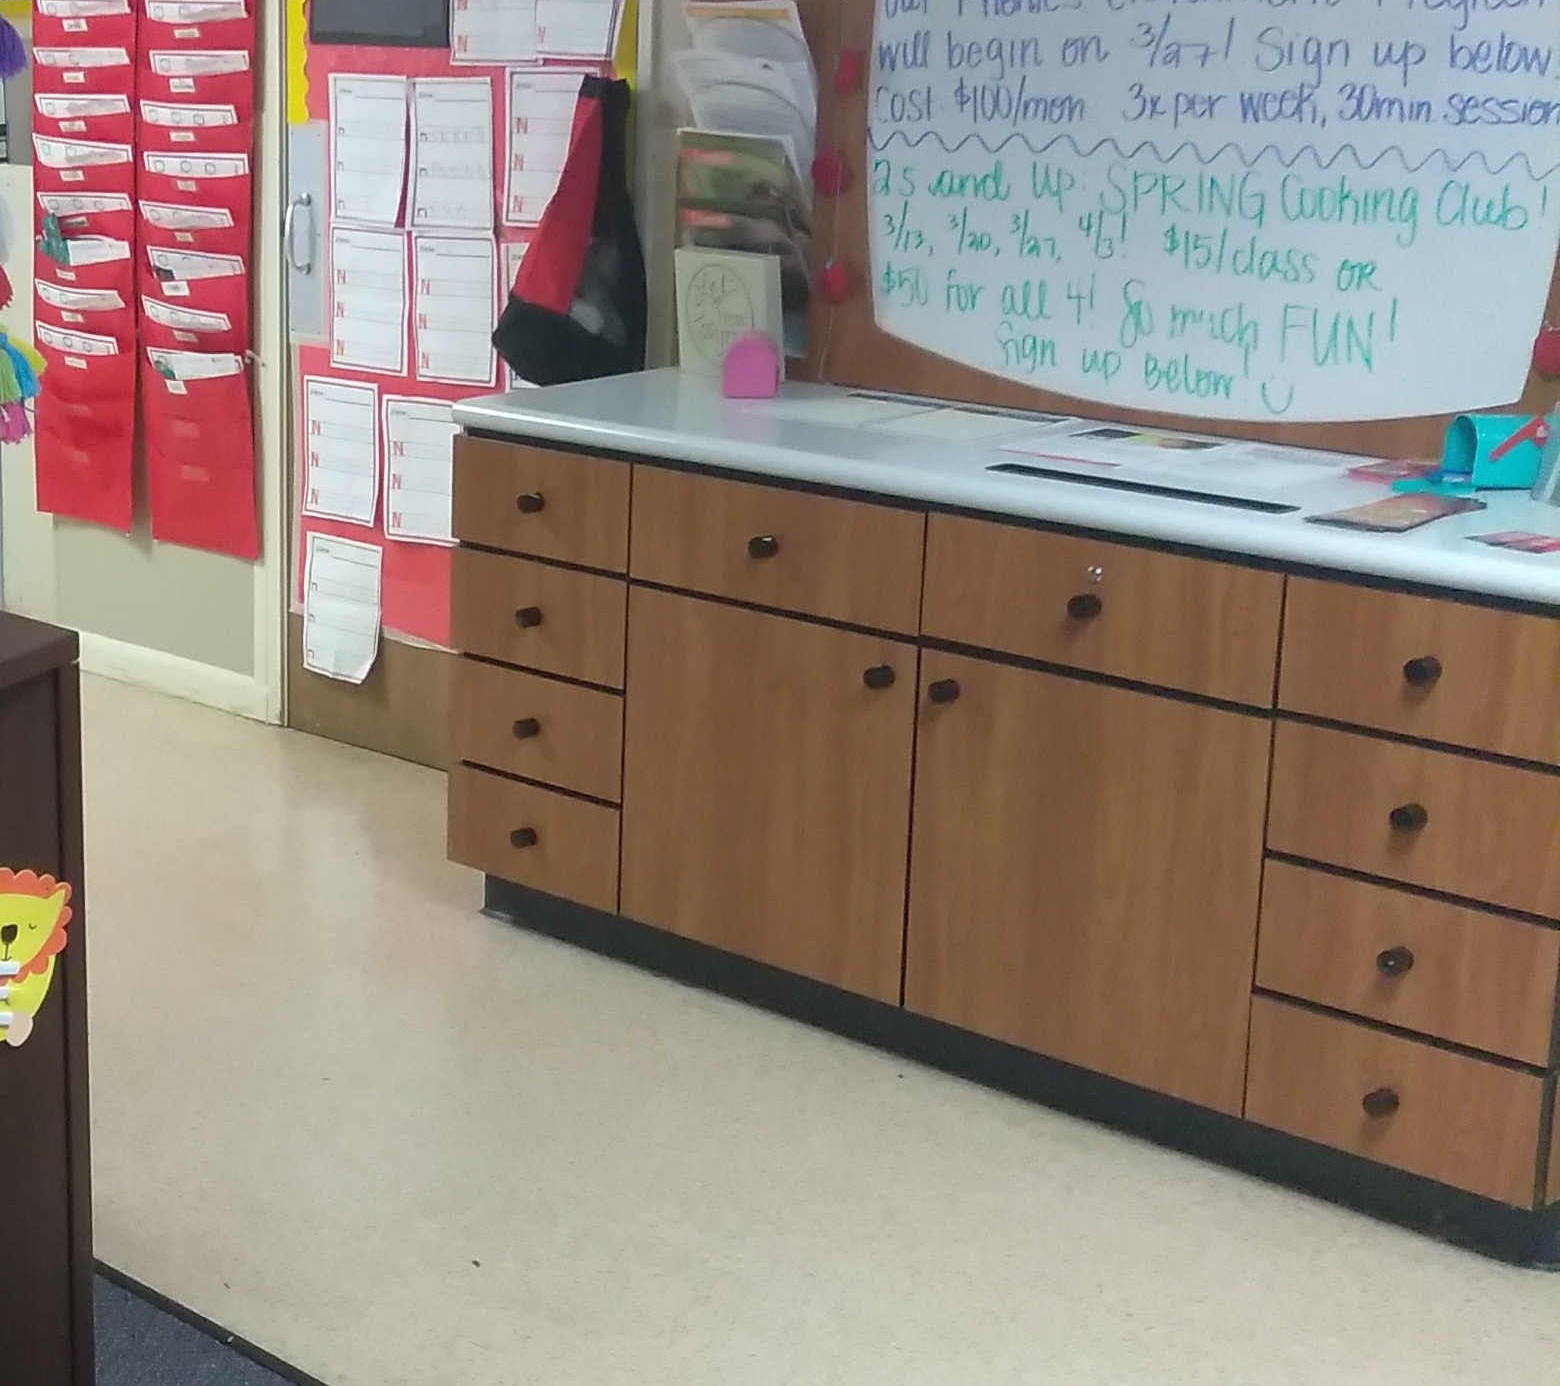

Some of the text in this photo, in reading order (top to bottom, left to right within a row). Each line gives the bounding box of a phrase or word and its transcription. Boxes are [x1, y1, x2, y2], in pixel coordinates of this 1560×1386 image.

[877, 29, 932, 73] will
[947, 30, 1044, 81] begin
[1061, 35, 1109, 63] on
[1256, 26, 1351, 88] Sign
[1374, 39, 1428, 88] up
[1174, 95, 1227, 130] per
[928, 159, 1011, 202] and
[1100, 163, 1267, 230] SPRING
[1279, 174, 1420, 249] Cooking
[882, 261, 930, 308] $50
[944, 269, 986, 314] for
[1000, 280, 1052, 320] all
[1081, 347, 1122, 385] up
